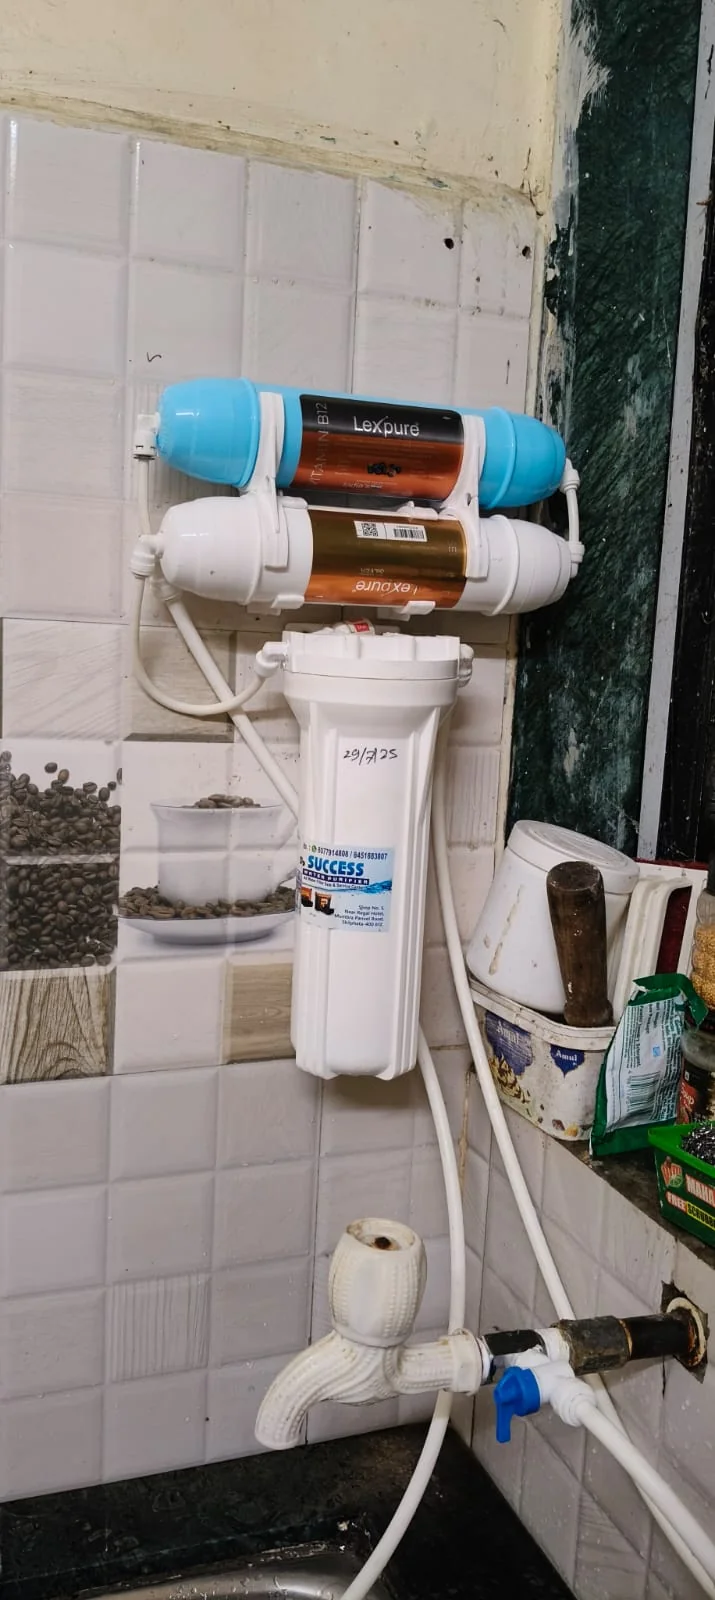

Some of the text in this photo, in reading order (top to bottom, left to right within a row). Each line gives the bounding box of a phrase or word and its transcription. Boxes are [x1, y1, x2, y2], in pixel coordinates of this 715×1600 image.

[315, 402, 329, 425] B12
[307, 855, 365, 876] SUCCESS
[555, 1049, 577, 1061] Amul
[666, 1191, 687, 1212] FREE
